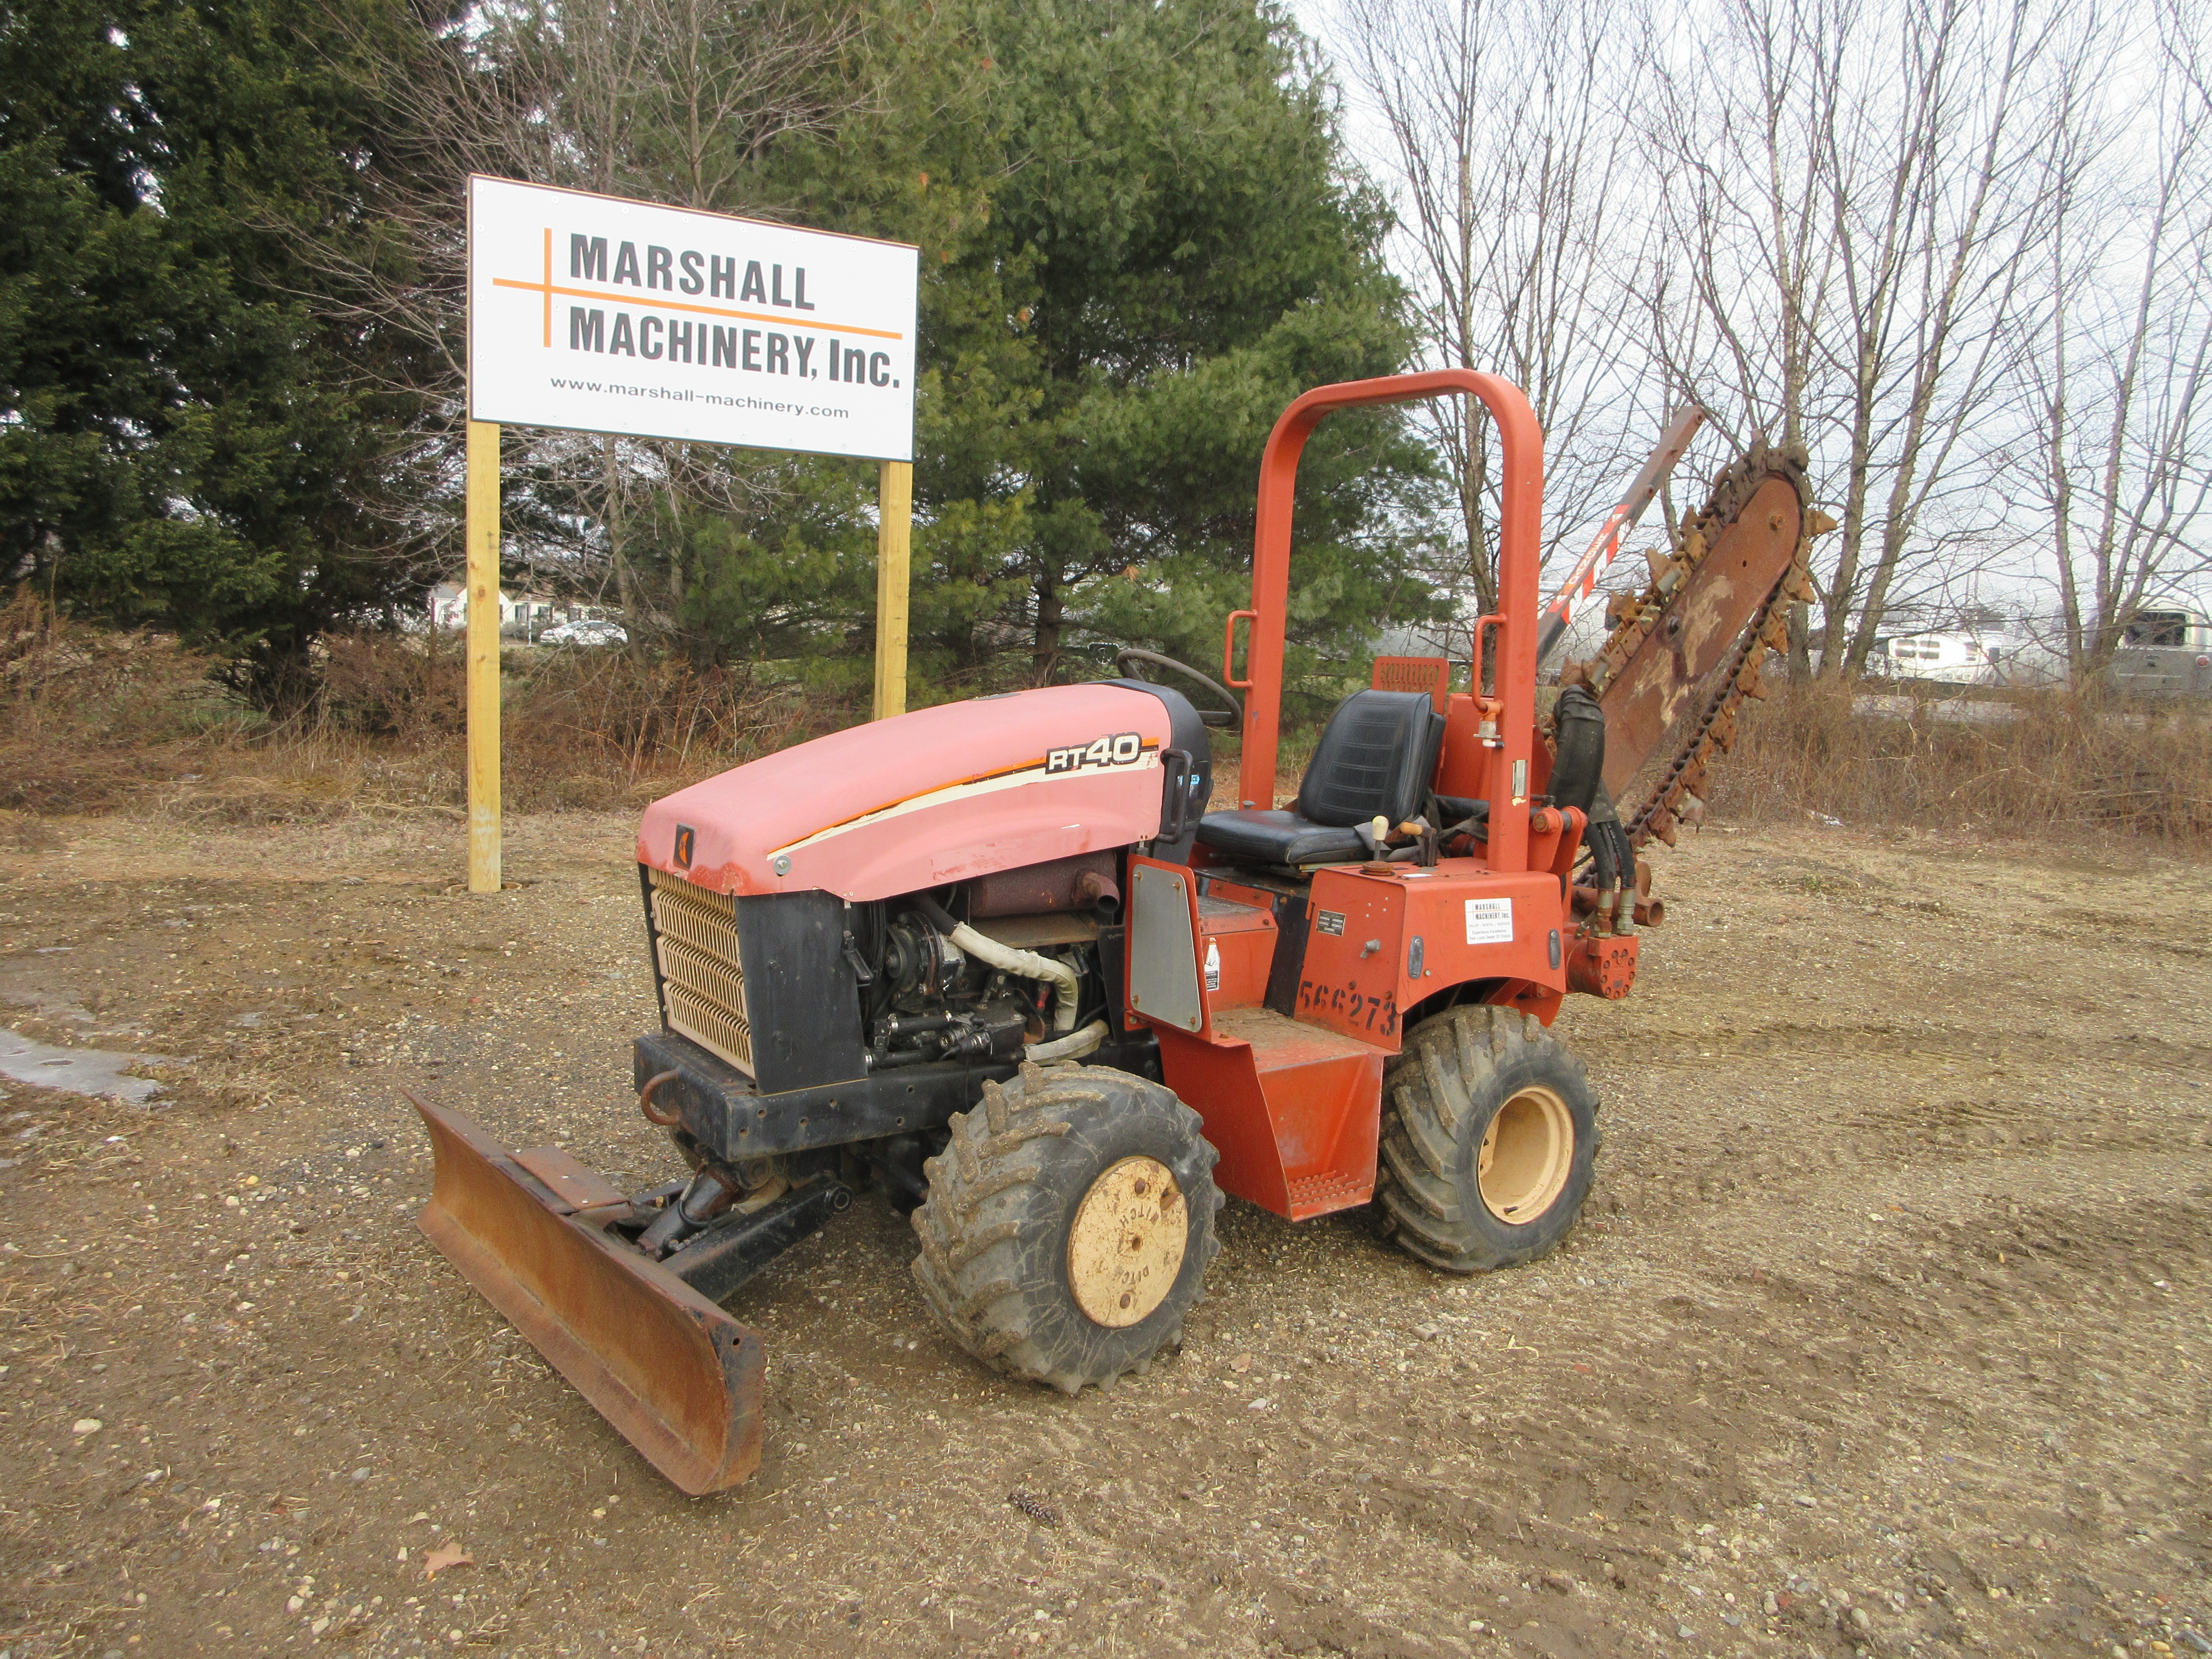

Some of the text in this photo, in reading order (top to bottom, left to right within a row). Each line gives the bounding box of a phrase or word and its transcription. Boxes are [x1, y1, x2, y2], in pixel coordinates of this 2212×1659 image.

[570, 233, 815, 311] MARSHALL
[569, 306, 900, 389] MACHINERY, Inc.
[550, 377, 849, 419] www.marshall-machinery.com
[1568, 533, 1610, 585] DANGER
[1048, 734, 1140, 771] RT40
[1300, 980, 1397, 1036] 566273
